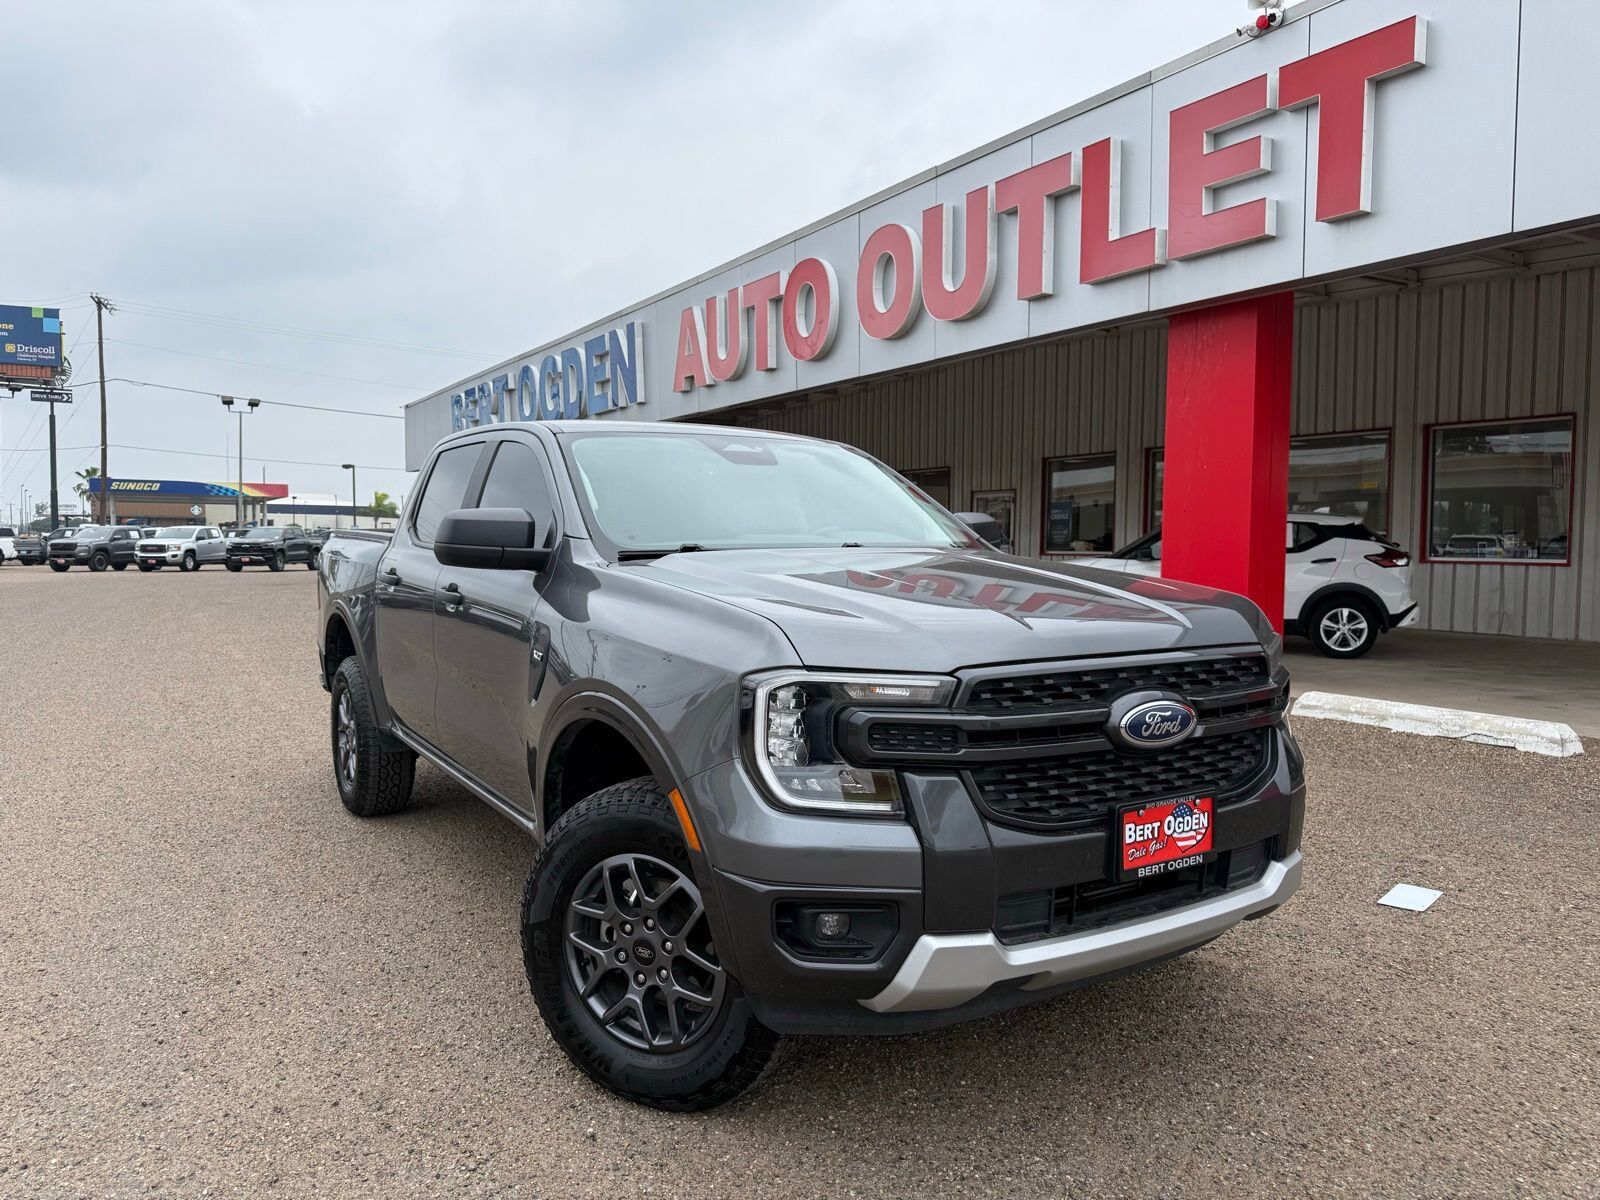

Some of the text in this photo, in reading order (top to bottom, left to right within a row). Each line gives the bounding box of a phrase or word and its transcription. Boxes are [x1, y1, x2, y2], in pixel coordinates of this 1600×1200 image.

[451, 14, 1428, 433] BERT OGDEN AUTO OUTLET
[17, 344, 55, 354] Driscoll
[111, 482, 160, 491] SUNOCO
[1141, 710, 1181, 737] Ford
[1156, 799, 1177, 808] GRANDE
[1125, 812, 1208, 845] BERT OGDEN
[1127, 846, 1147, 861] Dale
[1138, 855, 1203, 878] BERT OGDEN
